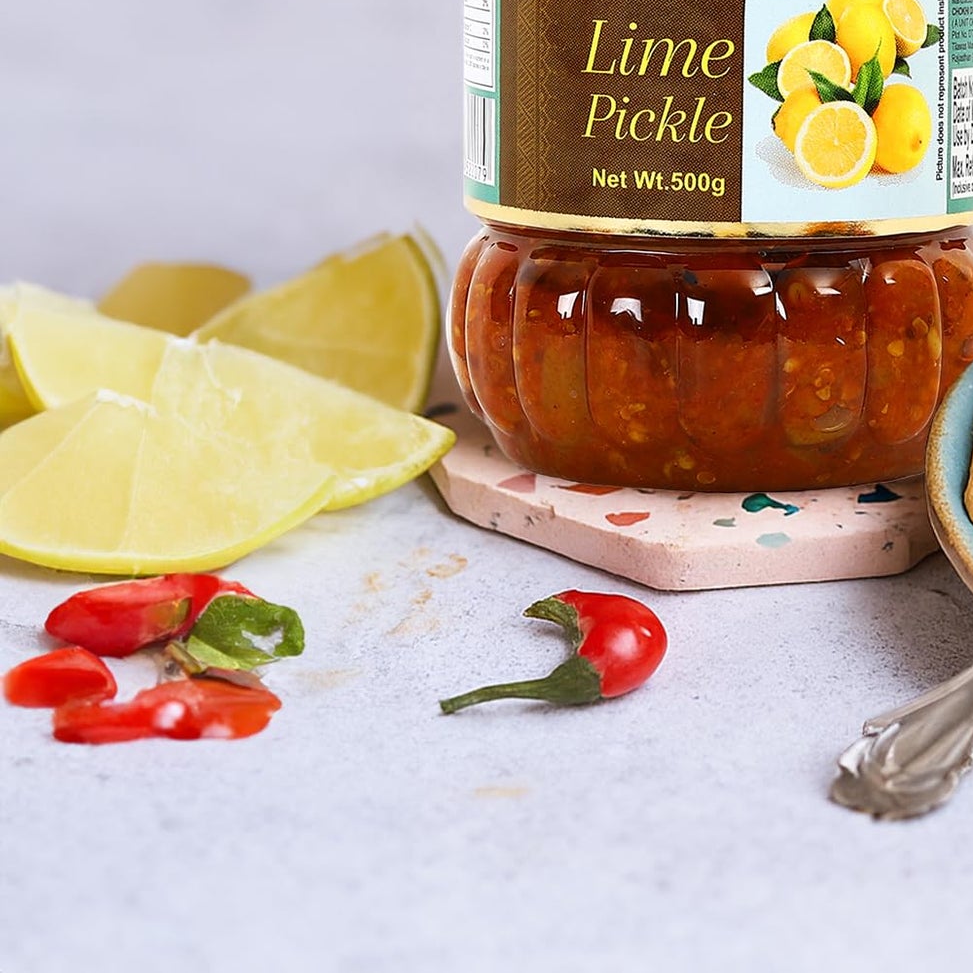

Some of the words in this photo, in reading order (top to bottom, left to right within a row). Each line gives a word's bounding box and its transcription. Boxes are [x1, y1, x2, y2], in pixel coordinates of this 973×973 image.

[581, 19, 735, 79] Lime
[938, 17, 946, 53] product
[938, 55, 946, 101] represent
[582, 93, 733, 144] Pickle
[953, 101, 965, 124] Date
[592, 167, 628, 189] Net
[634, 170, 726, 197] Wt.500g
[936, 147, 944, 181] Picture
